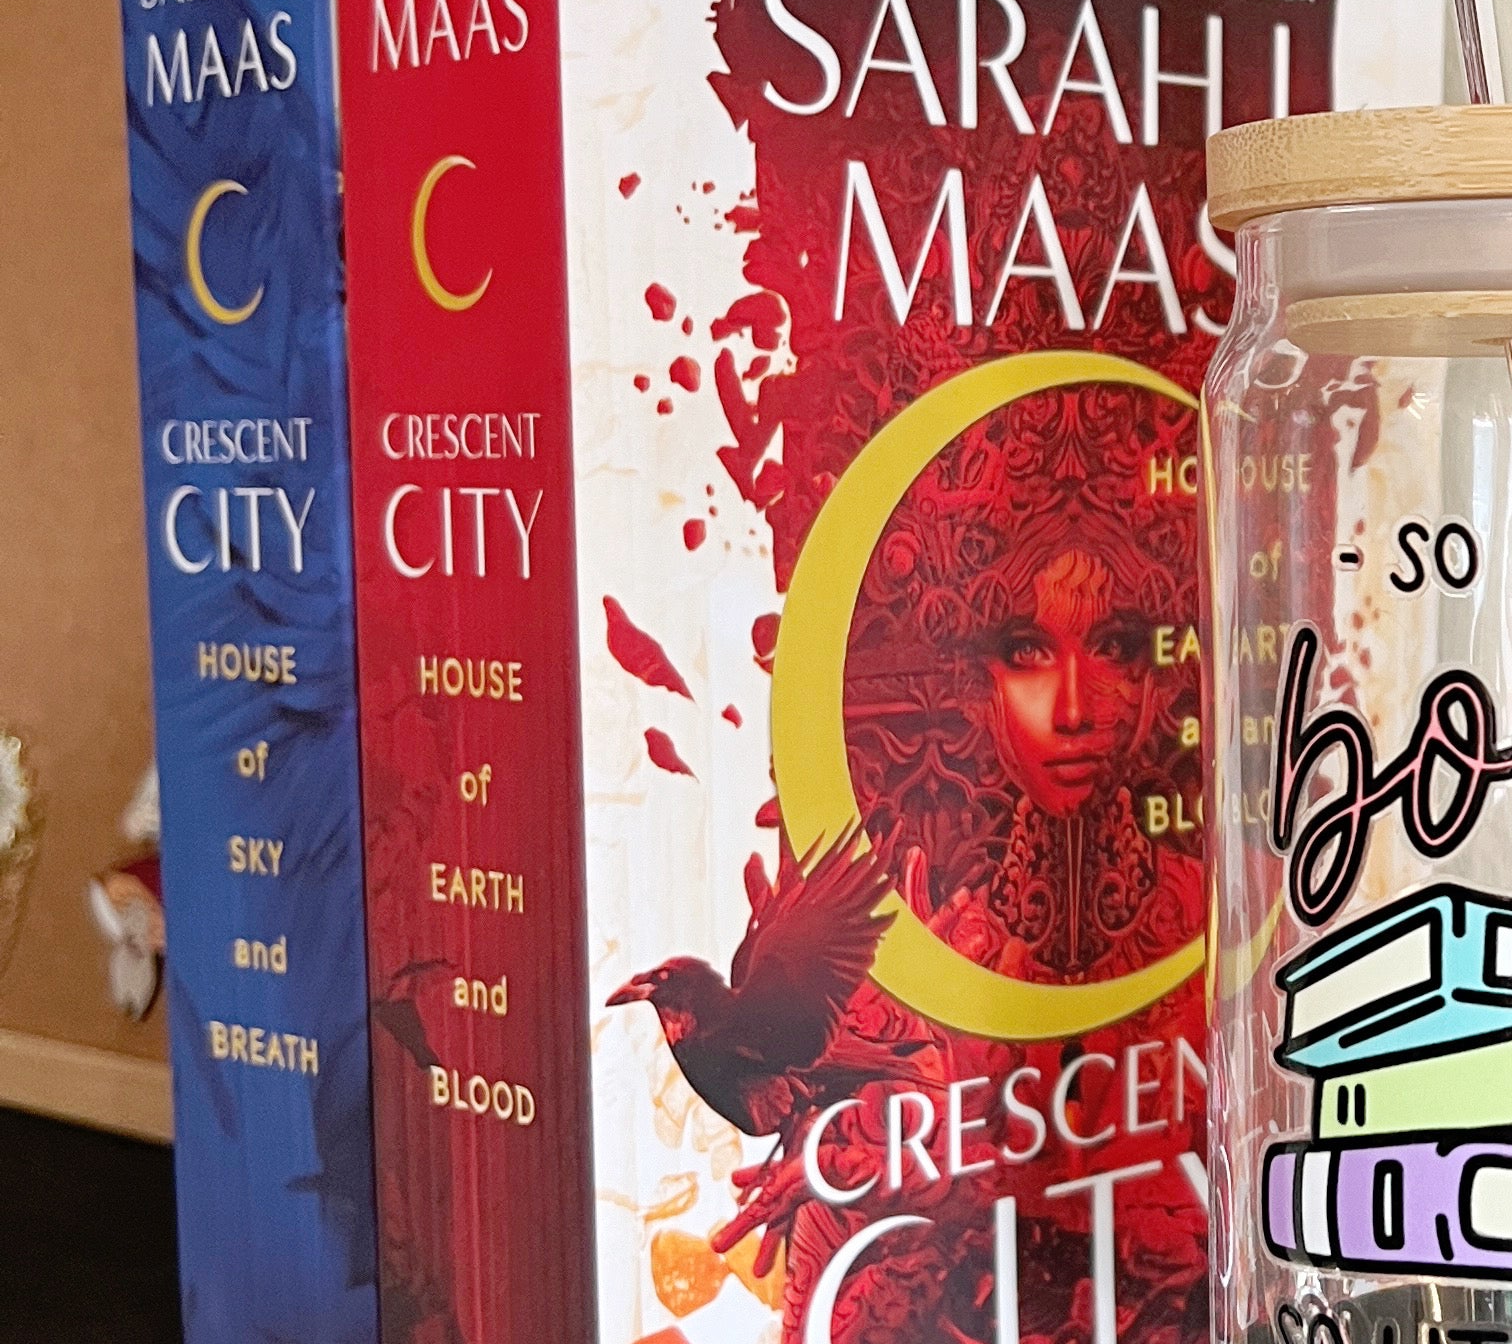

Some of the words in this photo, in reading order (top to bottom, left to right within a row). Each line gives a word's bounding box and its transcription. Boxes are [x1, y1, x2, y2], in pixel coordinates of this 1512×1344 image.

[145, 13, 297, 107] MAAS
[161, 416, 313, 465] CRESCENT
[381, 412, 541, 460] CRESCENT
[164, 485, 316, 575] CITY
[383, 484, 543, 579] CITY
[1250, 540, 1283, 580] of
[1390, 522, 1478, 593] SO
[199, 642, 296, 686] HOUSE
[419, 655, 523, 702] HOUSE
[236, 740, 270, 781] of
[461, 763, 492, 804] of
[228, 835, 284, 877] SKY
[430, 862, 524, 914] EARTH
[233, 935, 287, 975] and
[453, 975, 508, 1016] and
[209, 1020, 319, 1076] BREATH
[429, 1064, 535, 1125] BLOOD
[804, 1036, 1207, 1204] CRESCEN
